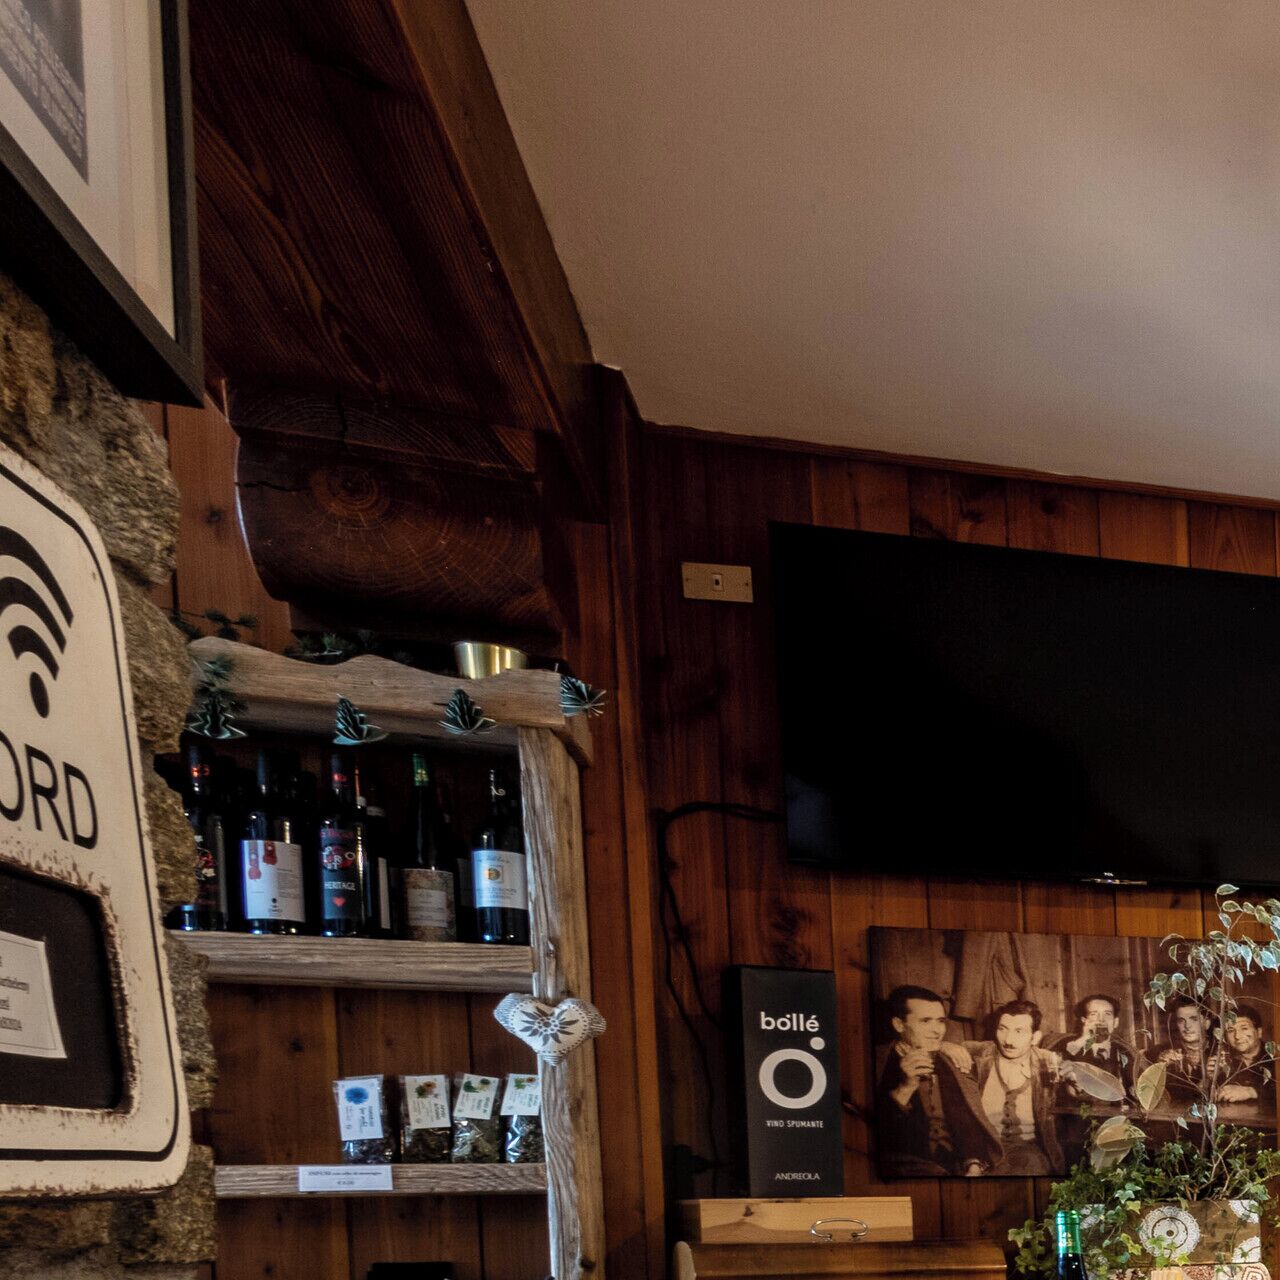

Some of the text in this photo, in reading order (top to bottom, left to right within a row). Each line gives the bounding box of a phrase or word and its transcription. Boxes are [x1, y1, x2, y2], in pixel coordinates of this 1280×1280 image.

[323, 880, 356, 891] HERITAGE
[766, 1120, 824, 1129] VINO SPUMANTE
[775, 1172, 821, 1181] ANDREOLA
